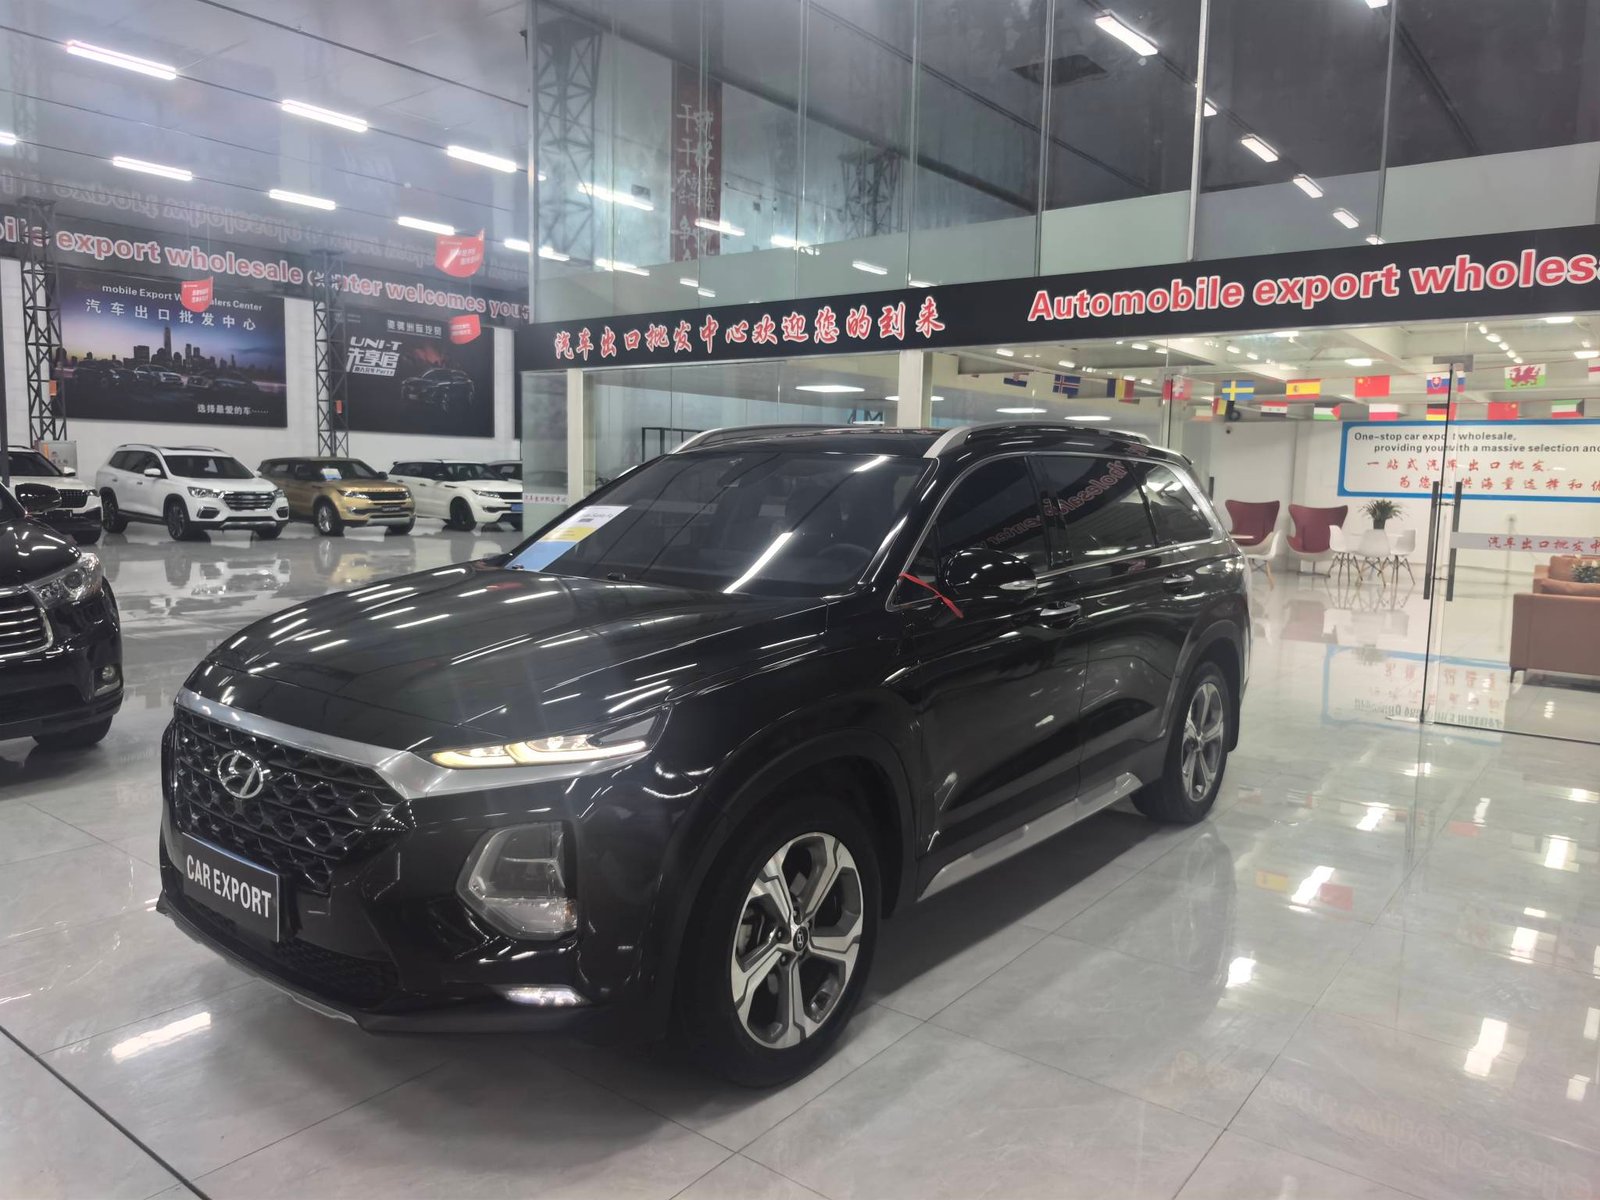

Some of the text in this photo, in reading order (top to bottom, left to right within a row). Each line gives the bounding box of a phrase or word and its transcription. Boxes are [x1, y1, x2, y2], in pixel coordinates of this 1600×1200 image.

[56, 231, 161, 264] export
[165, 245, 303, 284] wholesale
[386, 282, 486, 313] welcomes
[1027, 249, 1600, 322] Automobile export wholes
[85, 298, 256, 331] 汽车出口批发中心
[102, 284, 137, 296] mobile
[139, 288, 172, 301] Export
[232, 300, 263, 312] Center
[350, 336, 403, 351] UNI-T
[554, 296, 945, 361] 汽车出口批发中心欢迎您的到来
[1354, 432, 1401, 442] One-stop
[1404, 433, 1420, 441] car
[1422, 433, 1456, 442] expot
[1374, 443, 1422, 453] providing
[1481, 443, 1525, 453] massive
[1528, 443, 1580, 453] selection
[186, 854, 271, 918] CAR EXPORT
